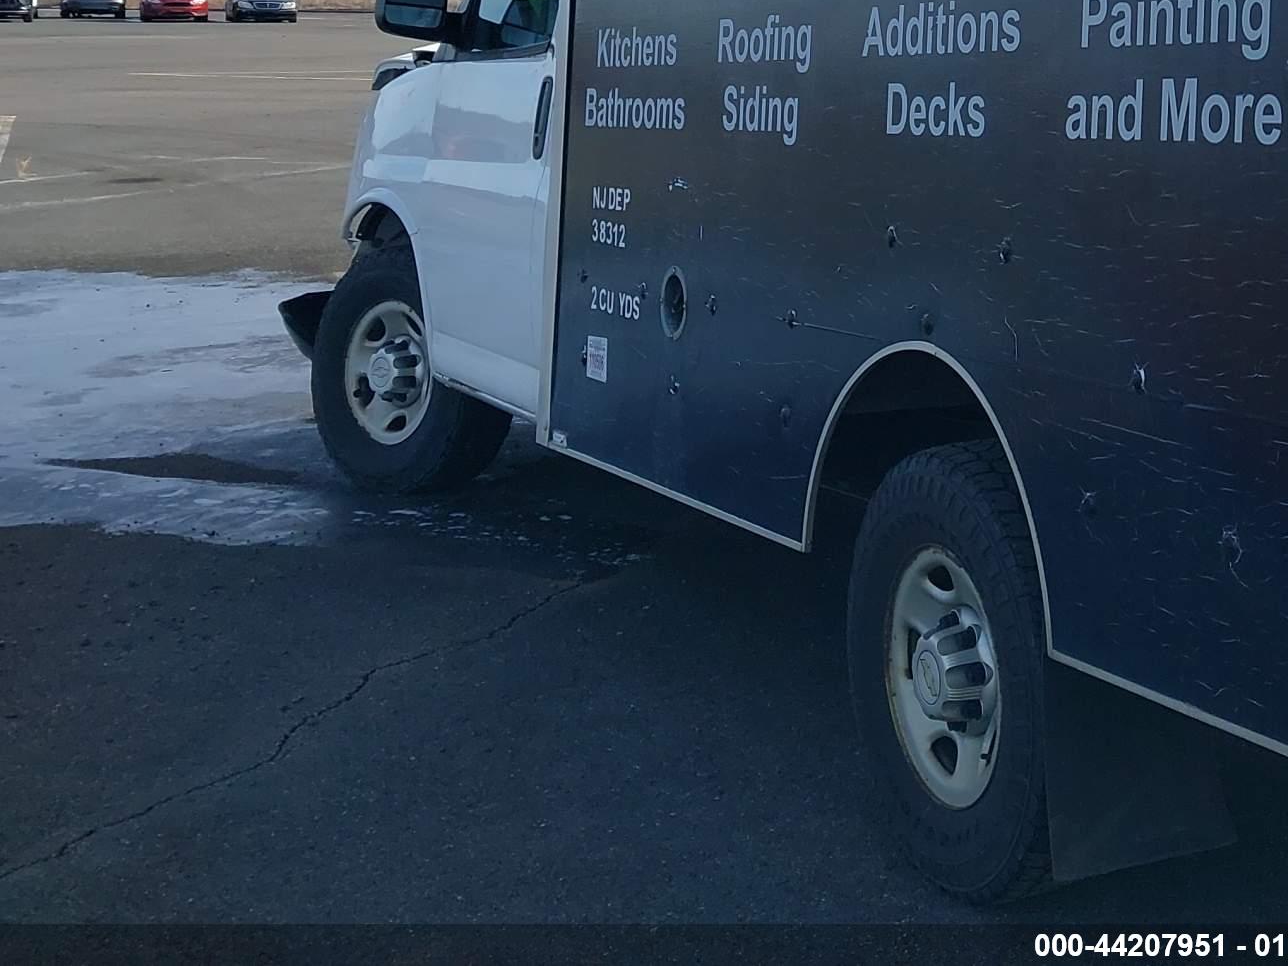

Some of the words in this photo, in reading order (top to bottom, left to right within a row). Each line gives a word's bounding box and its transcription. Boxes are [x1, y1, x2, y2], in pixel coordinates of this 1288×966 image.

[597, 26, 677, 67] Kitchens
[718, 15, 812, 73] Roofing
[862, 1, 1021, 57] Additions
[585, 88, 685, 130] Bathrooms
[722, 85, 799, 146] Siding
[886, 81, 985, 138] Decks
[1065, 79, 1143, 141] and
[1160, 77, 1283, 145] More
[593, 186, 606, 210] NJ
[609, 188, 631, 211] DEP
[591, 218, 626, 248] 38312
[591, 286, 597, 310] 2
[600, 288, 614, 314] CU
[618, 293, 640, 320] YDS
